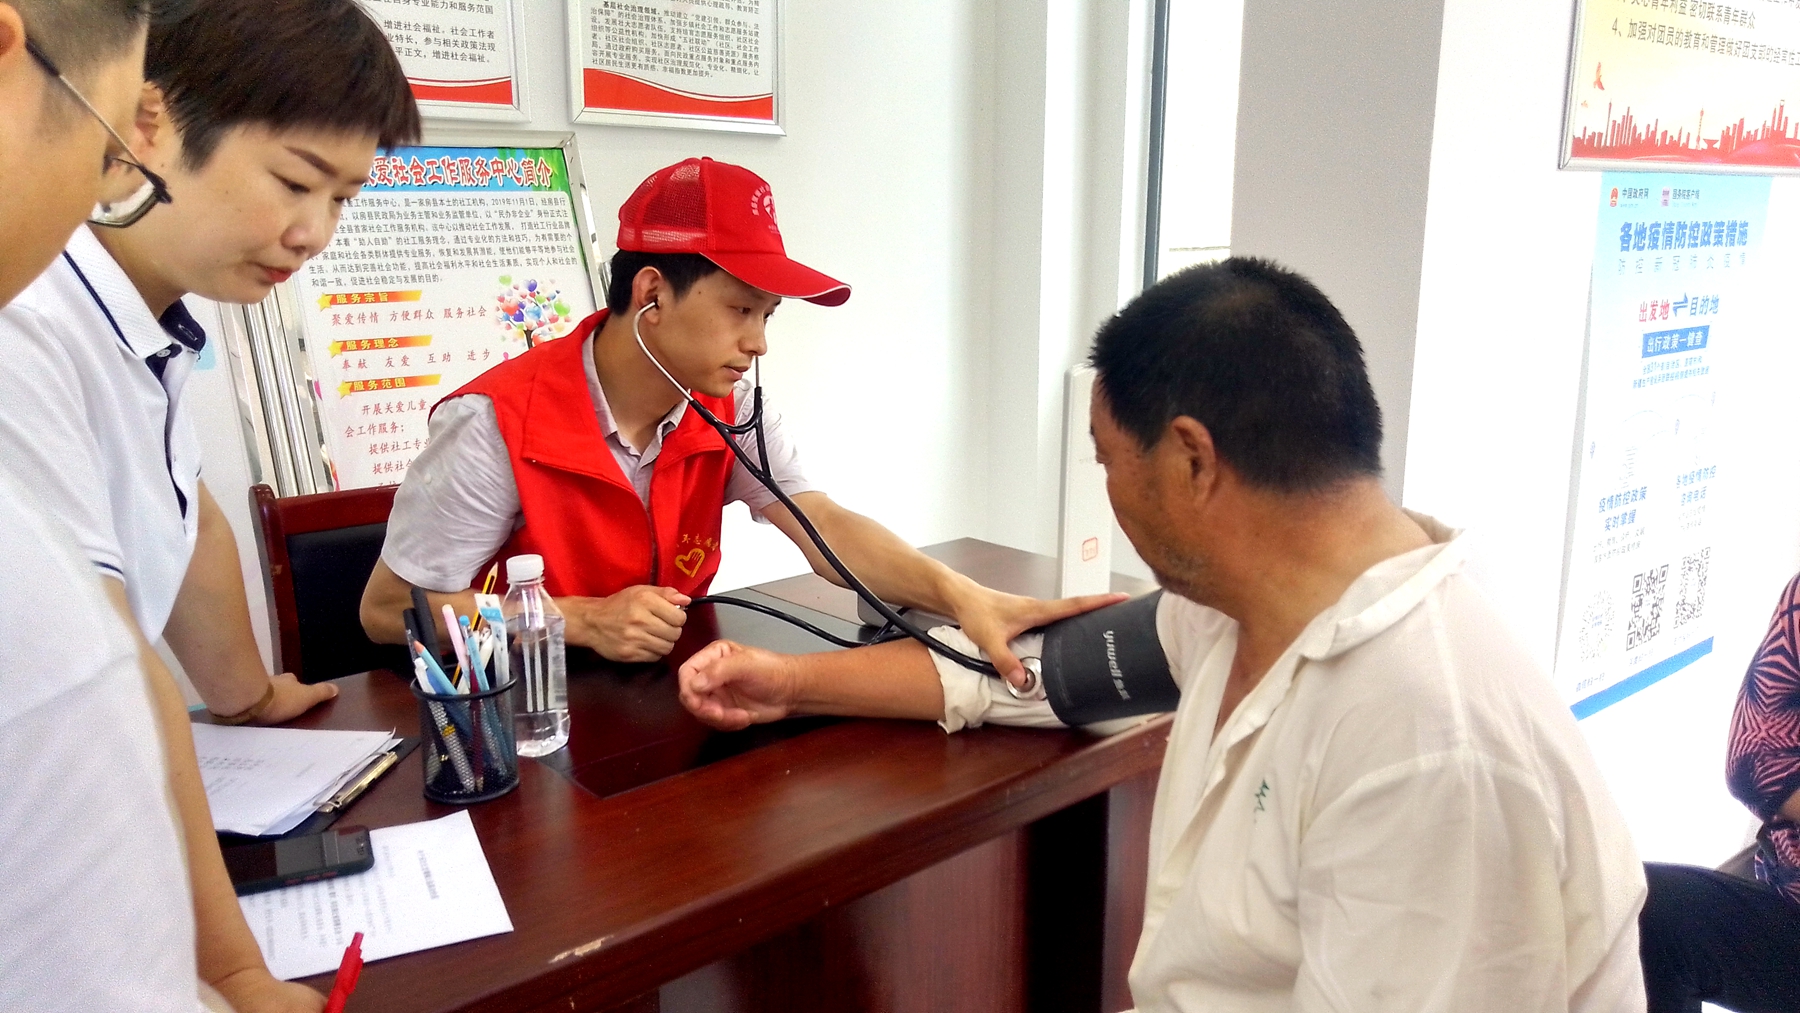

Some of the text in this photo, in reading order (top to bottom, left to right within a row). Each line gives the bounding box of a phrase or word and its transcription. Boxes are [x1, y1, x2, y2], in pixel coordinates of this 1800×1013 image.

[1620, 220, 1749, 252] 各地疫情防控政策措施
[336, 292, 388, 305] 服务宗旨
[1638, 294, 1719, 323] 出发地 目的地
[332, 306, 487, 326] 聚爱传情 方便群众 服务社会
[346, 337, 399, 351] 服务理念
[342, 349, 490, 371] 奉献 友爱 互助 进步
[353, 377, 406, 391] 服务范围
[1599, 486, 1647, 513] 疫情防控政策
[1102, 630, 1123, 678] yuwell
